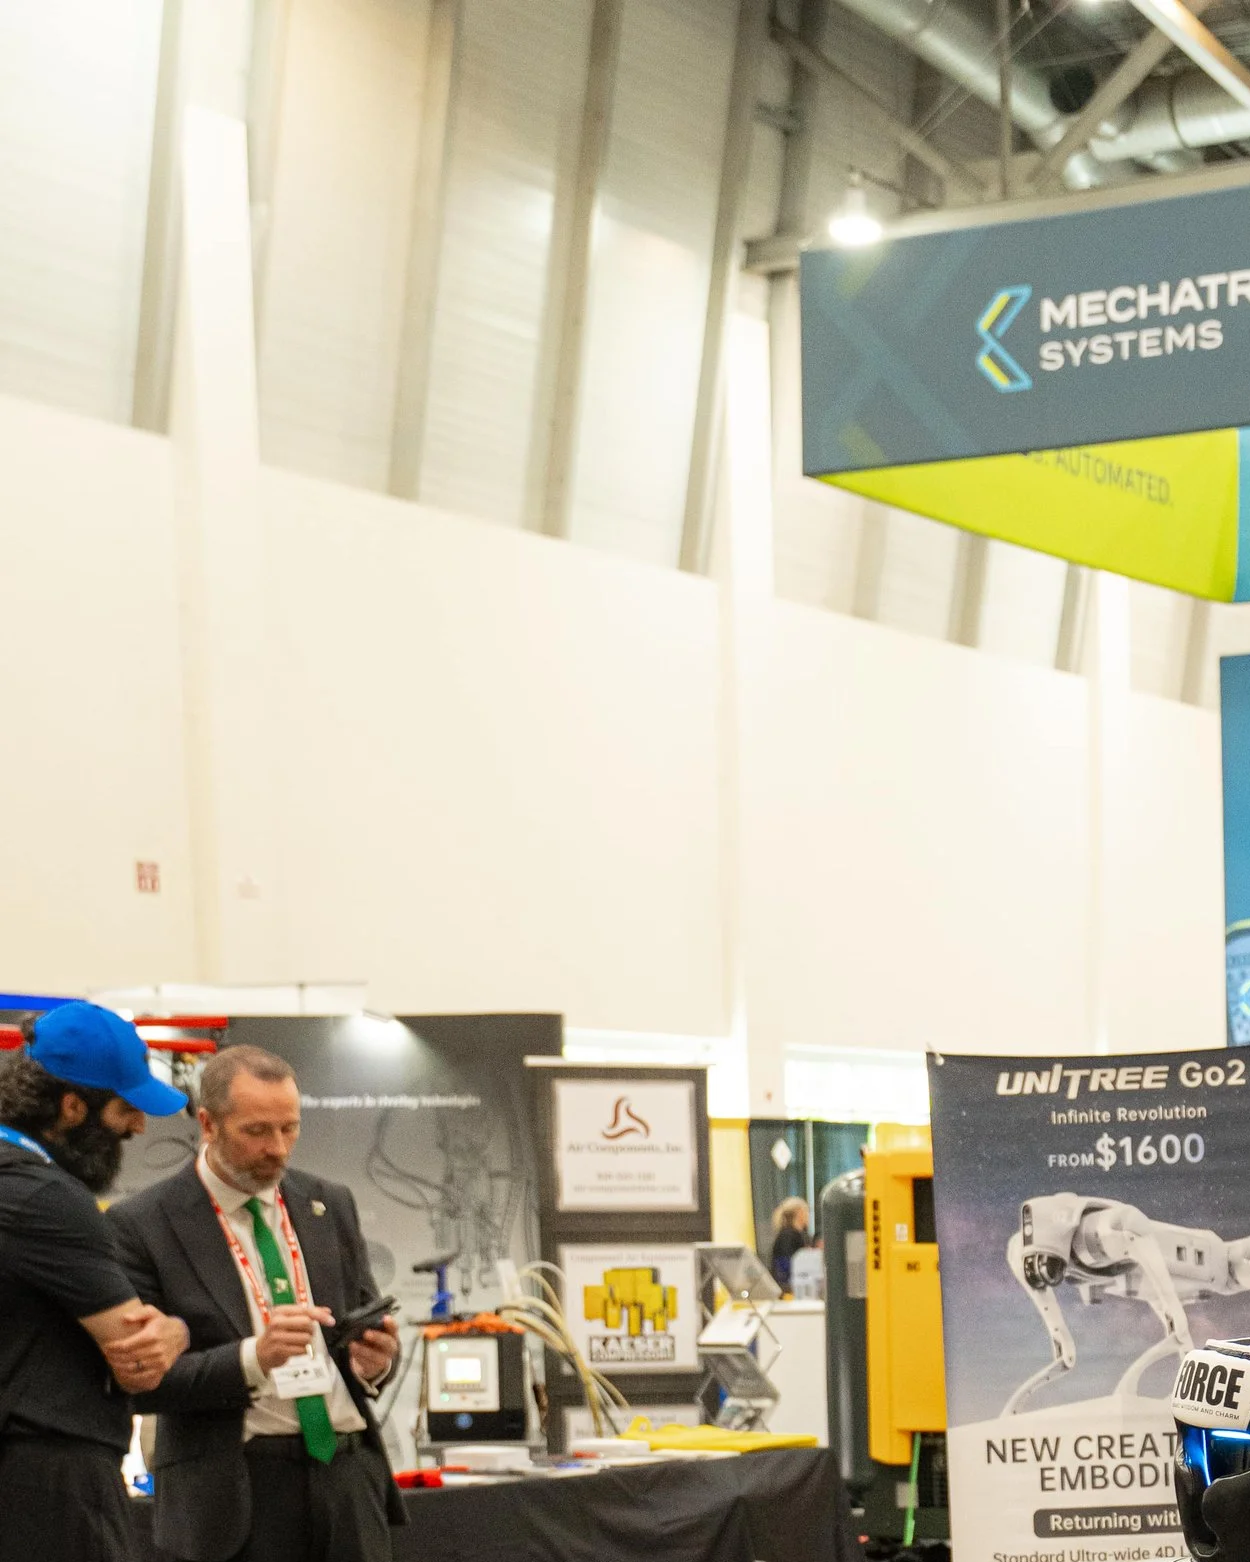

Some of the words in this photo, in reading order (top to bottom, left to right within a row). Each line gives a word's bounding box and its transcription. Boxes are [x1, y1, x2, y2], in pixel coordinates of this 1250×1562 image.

[1039, 319, 1224, 372] SYSTEMS
[997, 1064, 1169, 1099] UNITREE
[1179, 1059, 1247, 1088] Go2
[1051, 1107, 1111, 1125] Infinite
[1117, 1104, 1208, 1122] Revolution
[1096, 1133, 1206, 1172] $1600
[1174, 1360, 1246, 1410] FORCE
[1215, 1410, 1240, 1421] CHARM
[985, 1436, 1062, 1465] NEW
[1049, 1514, 1142, 1532] Returning
[1155, 1545, 1176, 1559] 4D
